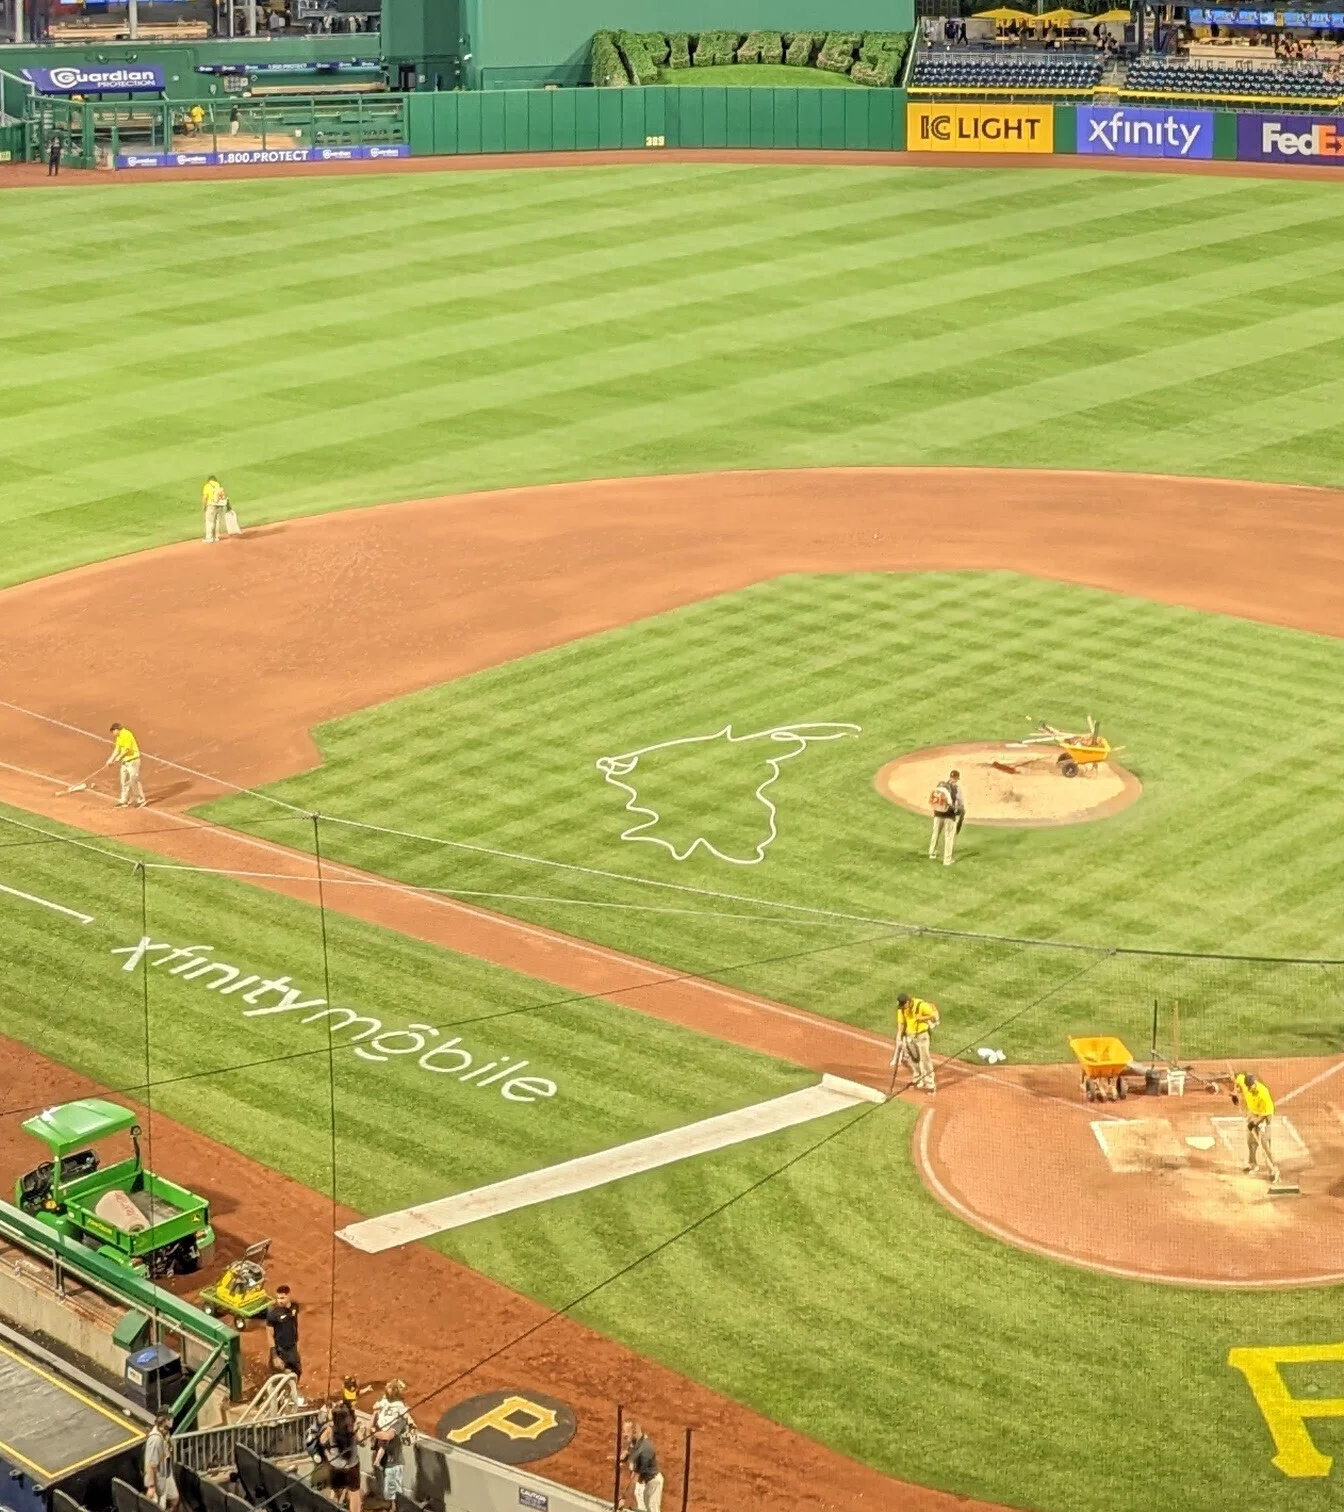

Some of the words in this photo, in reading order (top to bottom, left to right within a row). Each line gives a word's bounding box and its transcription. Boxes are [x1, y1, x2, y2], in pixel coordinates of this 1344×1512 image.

[616, 29, 909, 87] PIRATES
[50, 67, 155, 89] Guardian
[97, 79, 156, 88] PROTECTION
[958, 117, 1041, 141] LIGHT
[1088, 112, 1201, 155] xfinity
[217, 149, 309, 165] 1.800.PROTECT
[446, 1395, 559, 1444] P
